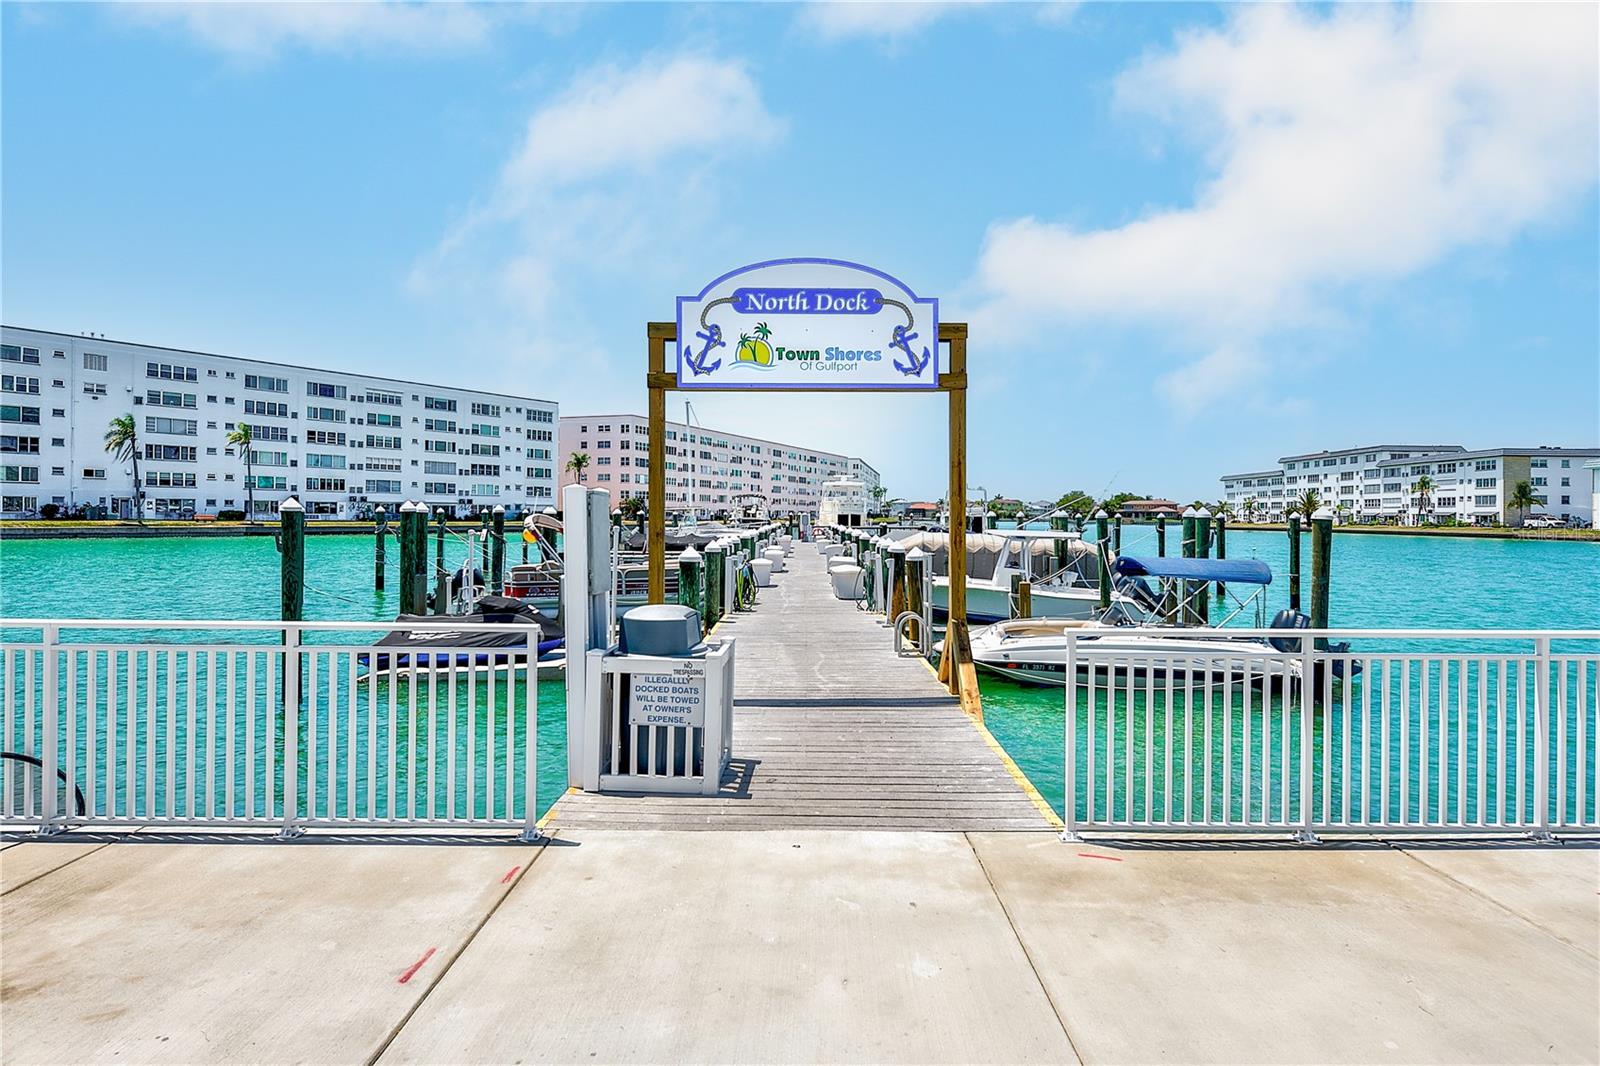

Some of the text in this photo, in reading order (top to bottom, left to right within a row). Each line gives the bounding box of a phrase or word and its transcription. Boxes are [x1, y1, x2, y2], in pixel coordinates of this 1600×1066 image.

[745, 292, 870, 312] North Dock
[776, 347, 882, 361] Town Shores
[800, 361, 858, 373] Of Gulfport
[635, 685, 699, 695] DOCKED BOATS
[636, 695, 656, 703] WILL
[654, 705, 692, 714] OWNER'S
